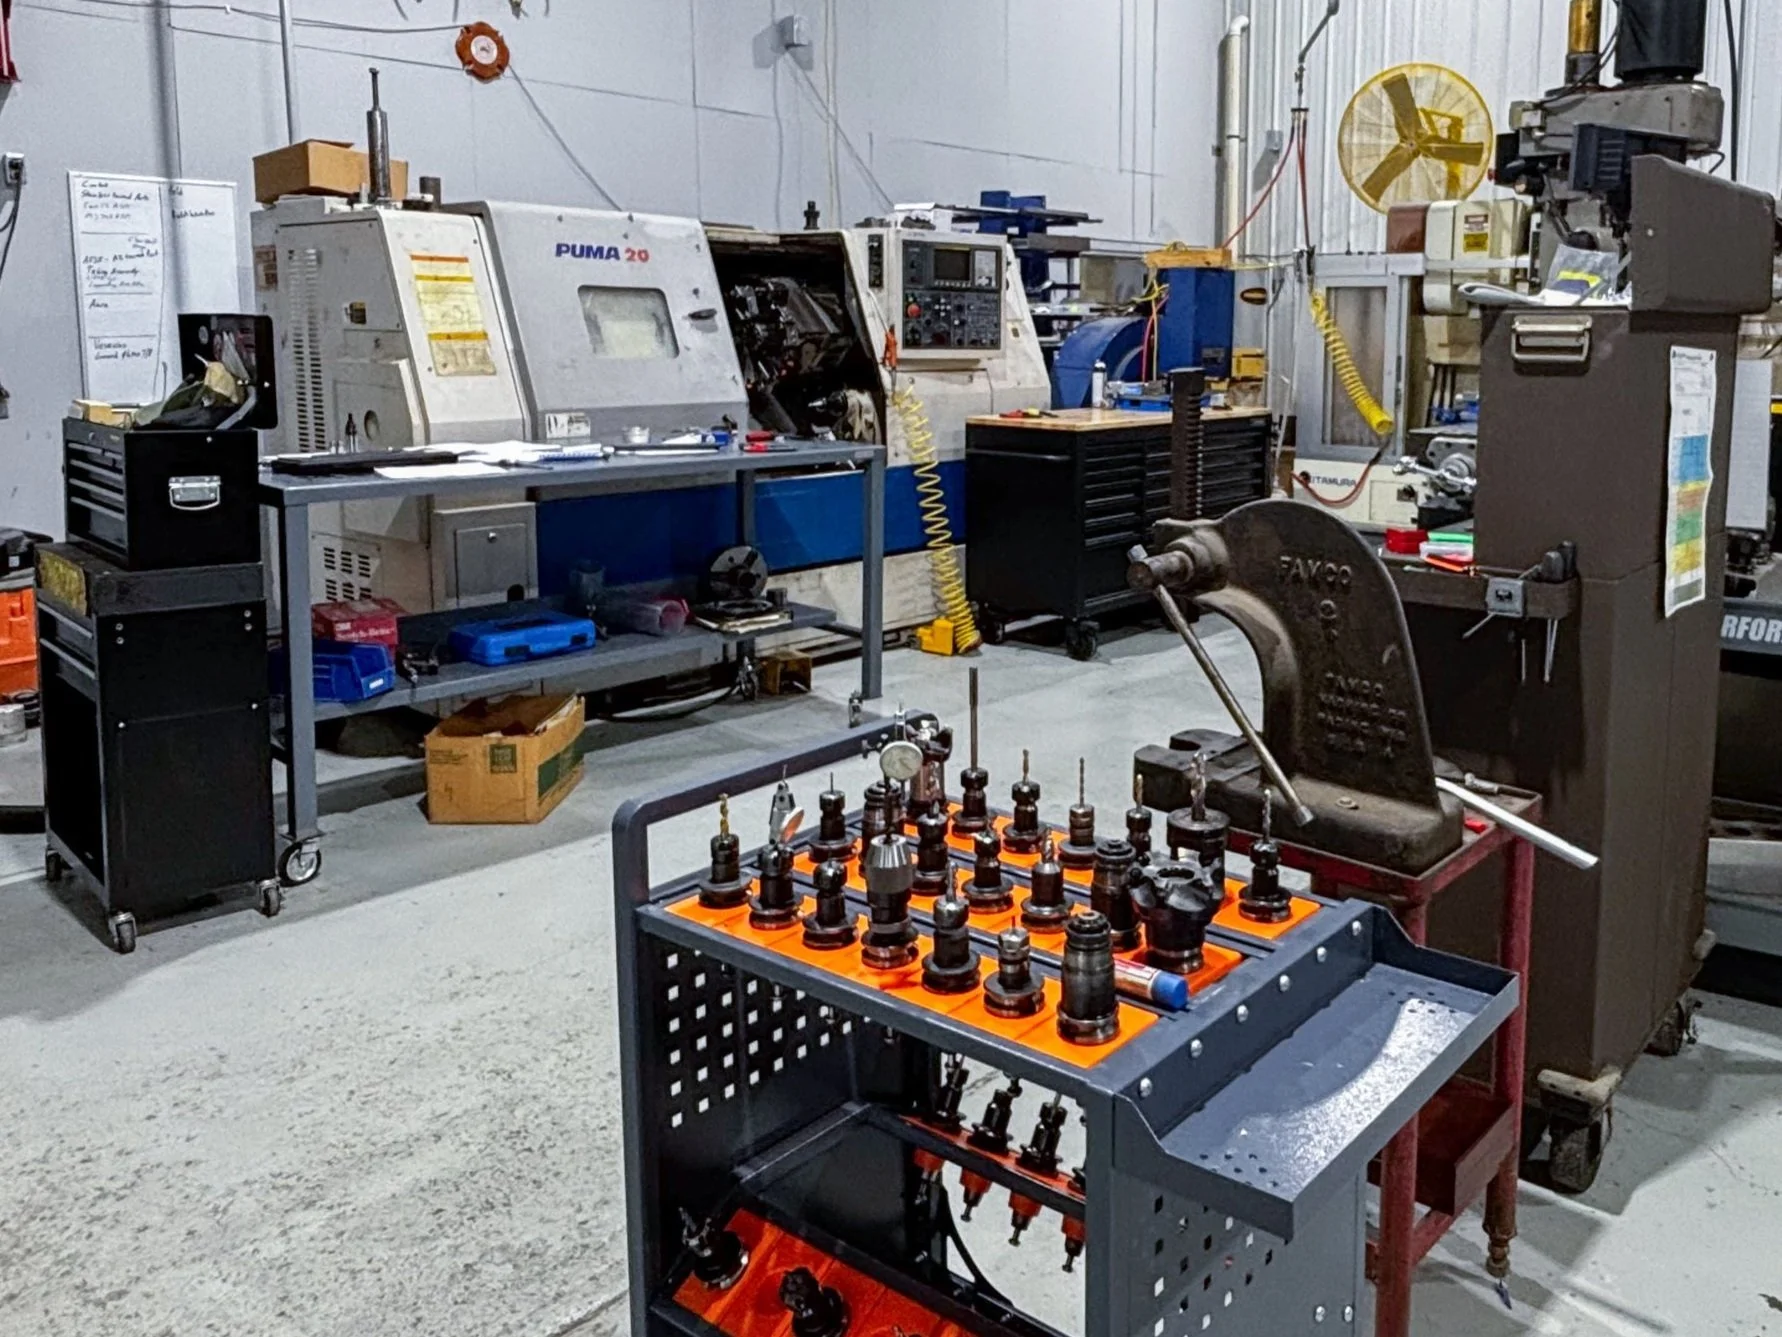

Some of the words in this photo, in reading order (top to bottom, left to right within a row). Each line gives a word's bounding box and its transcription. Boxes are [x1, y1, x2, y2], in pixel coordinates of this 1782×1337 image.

[555, 243, 620, 261] PUMA
[624, 247, 650, 263] 20
[1310, 475, 1357, 487] ITAMURA
[1280, 555, 1352, 585] FAYCO
